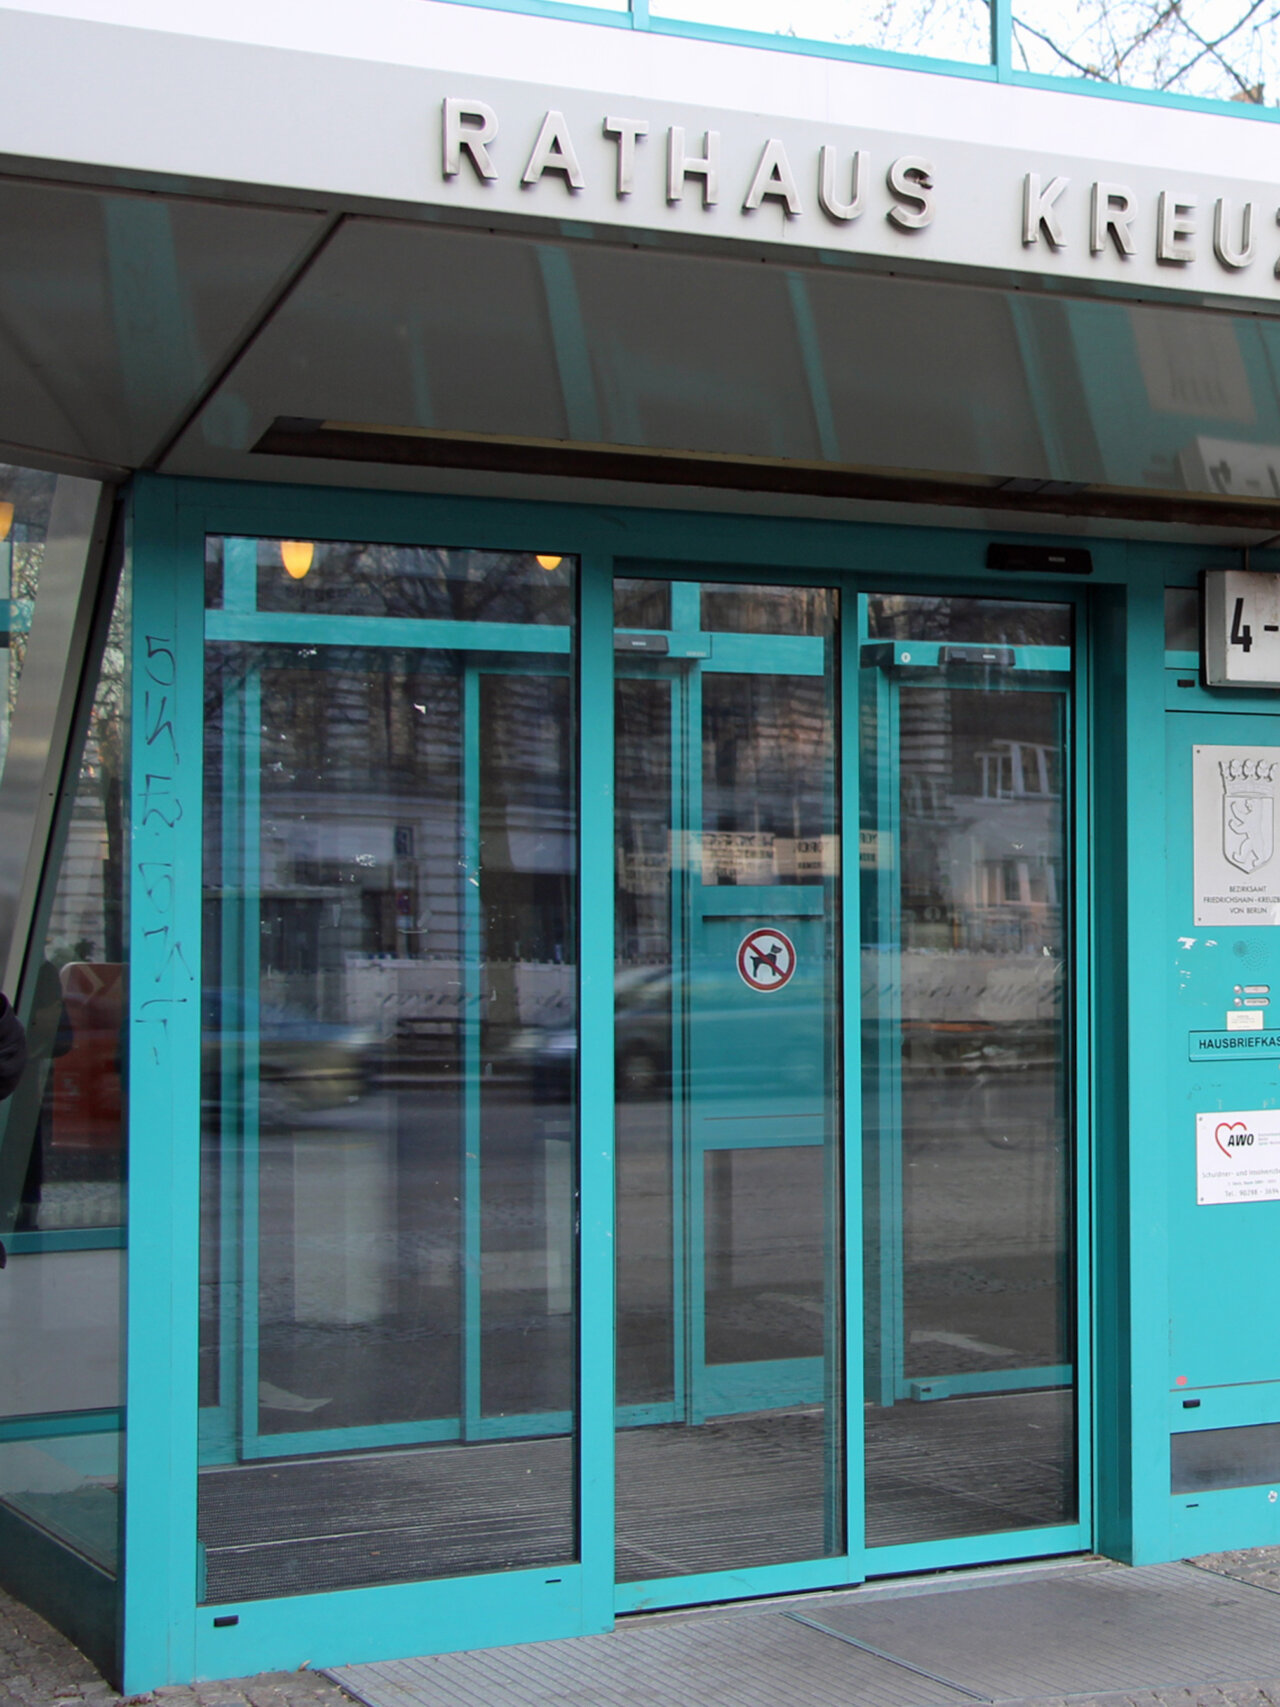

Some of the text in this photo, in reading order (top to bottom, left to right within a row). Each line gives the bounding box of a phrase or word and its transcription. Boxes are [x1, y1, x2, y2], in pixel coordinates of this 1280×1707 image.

[442, 97, 935, 230] RATHAUS
[1229, 885, 1267, 893] BEZIRKSAMT
[1229, 906, 1268, 914] VON BERLIN
[1228, 1133, 1255, 1147] AWO
